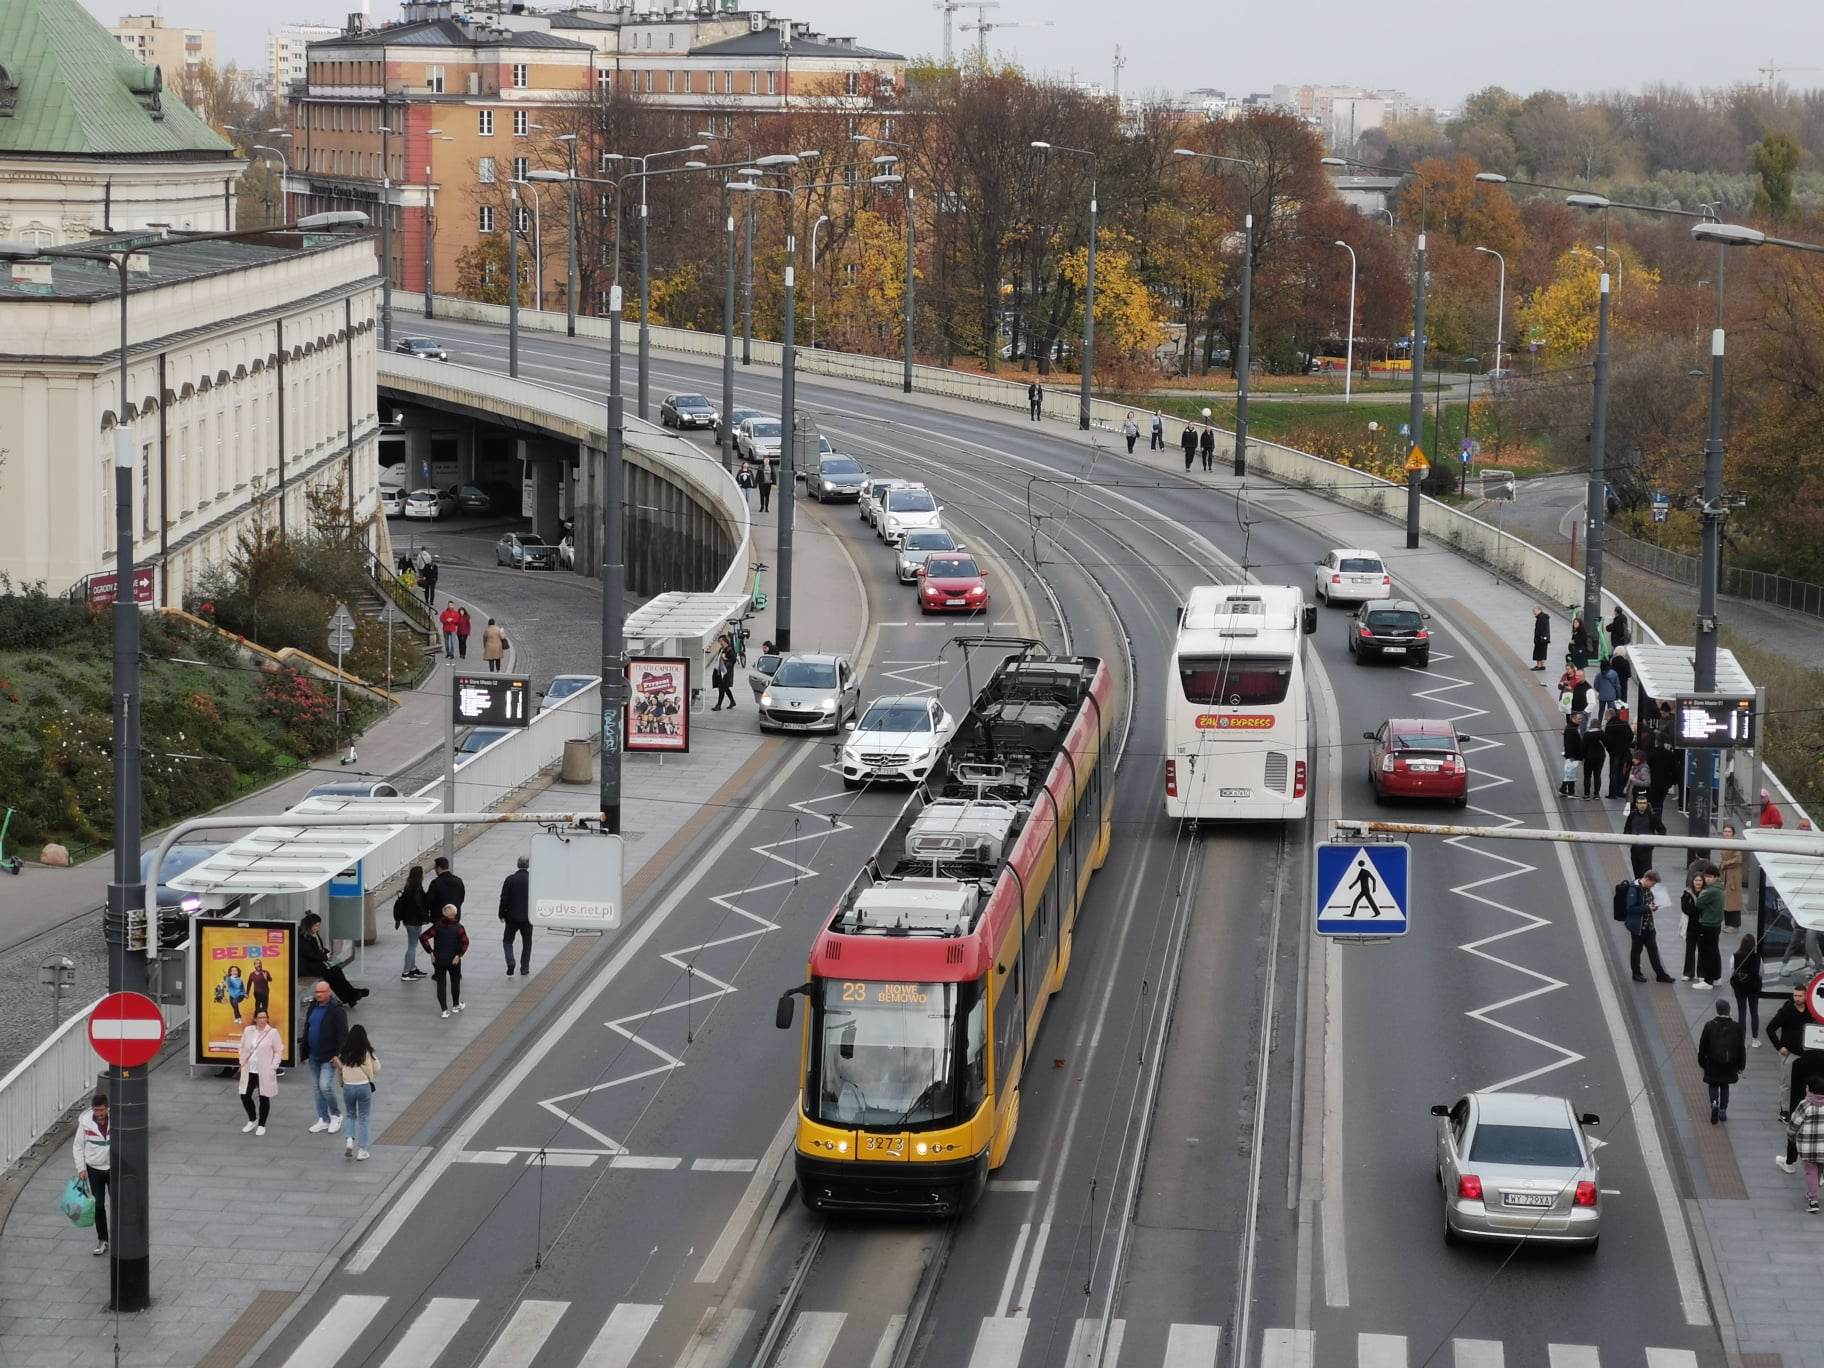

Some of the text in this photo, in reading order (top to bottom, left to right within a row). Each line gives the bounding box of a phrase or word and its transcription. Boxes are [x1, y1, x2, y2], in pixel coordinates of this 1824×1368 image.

[93, 583, 113, 593] OGRODY
[1230, 717, 1271, 727] EXPRESS
[212, 945, 281, 960] BEJBIS
[842, 982, 917, 1001] 23 NOWE
[878, 993, 927, 1003] BEMOWO
[865, 1136, 904, 1151] 3273
[1511, 1194, 1551, 1205] WY 729XA
